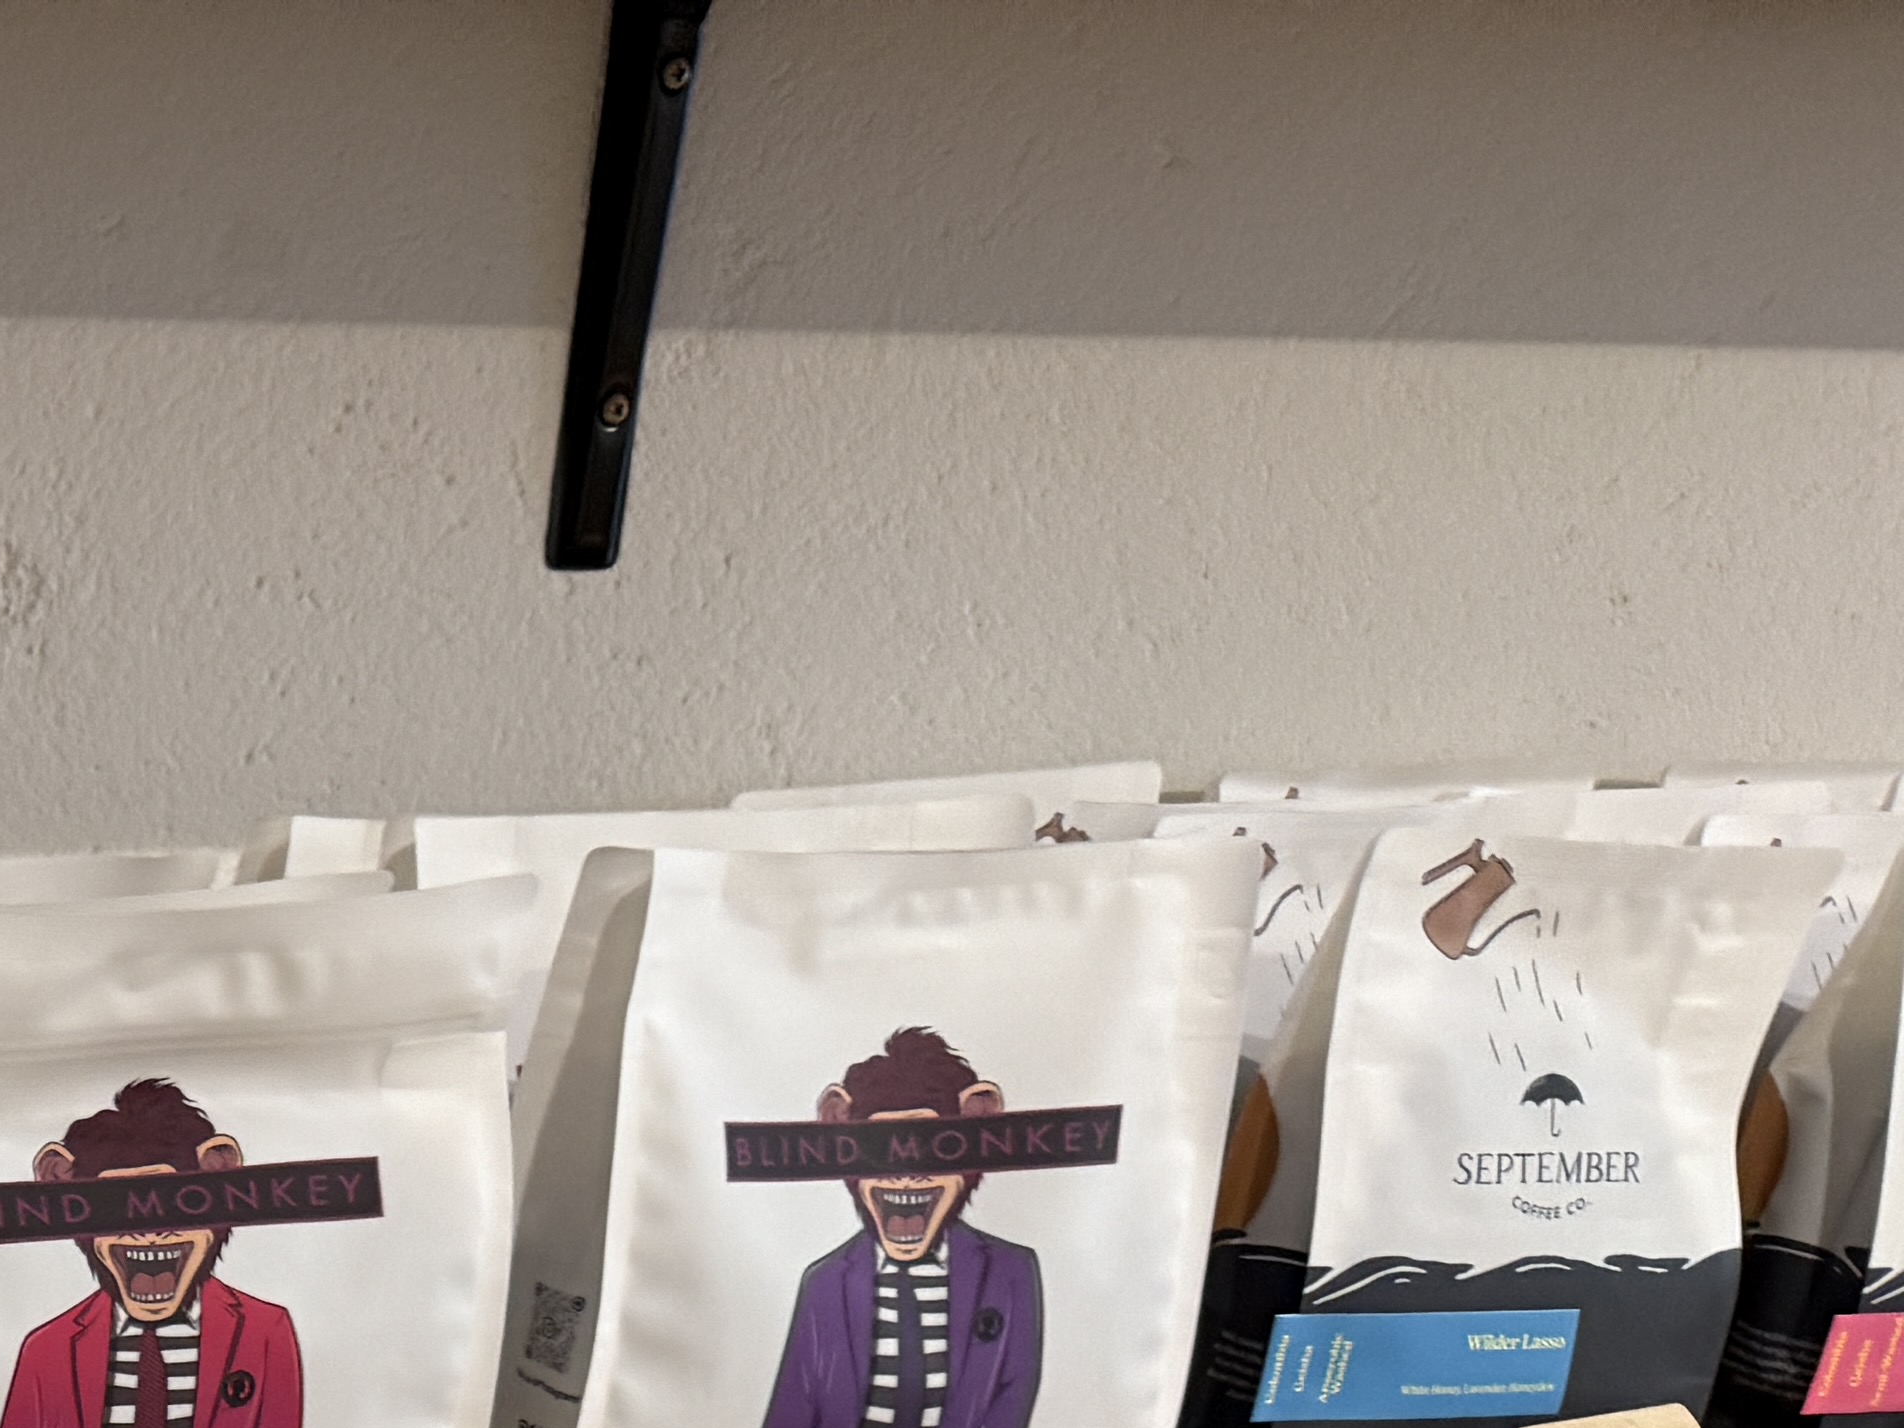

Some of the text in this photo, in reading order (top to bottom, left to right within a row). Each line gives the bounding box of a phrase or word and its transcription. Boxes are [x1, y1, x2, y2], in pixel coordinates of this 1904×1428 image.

[735, 1121, 1112, 1166] BLIND MONKEY
[1452, 1151, 1640, 1185] SEPTEMBER
[128, 1173, 364, 1218] MONKEY
[1512, 1195, 1562, 1220] COFFEE
